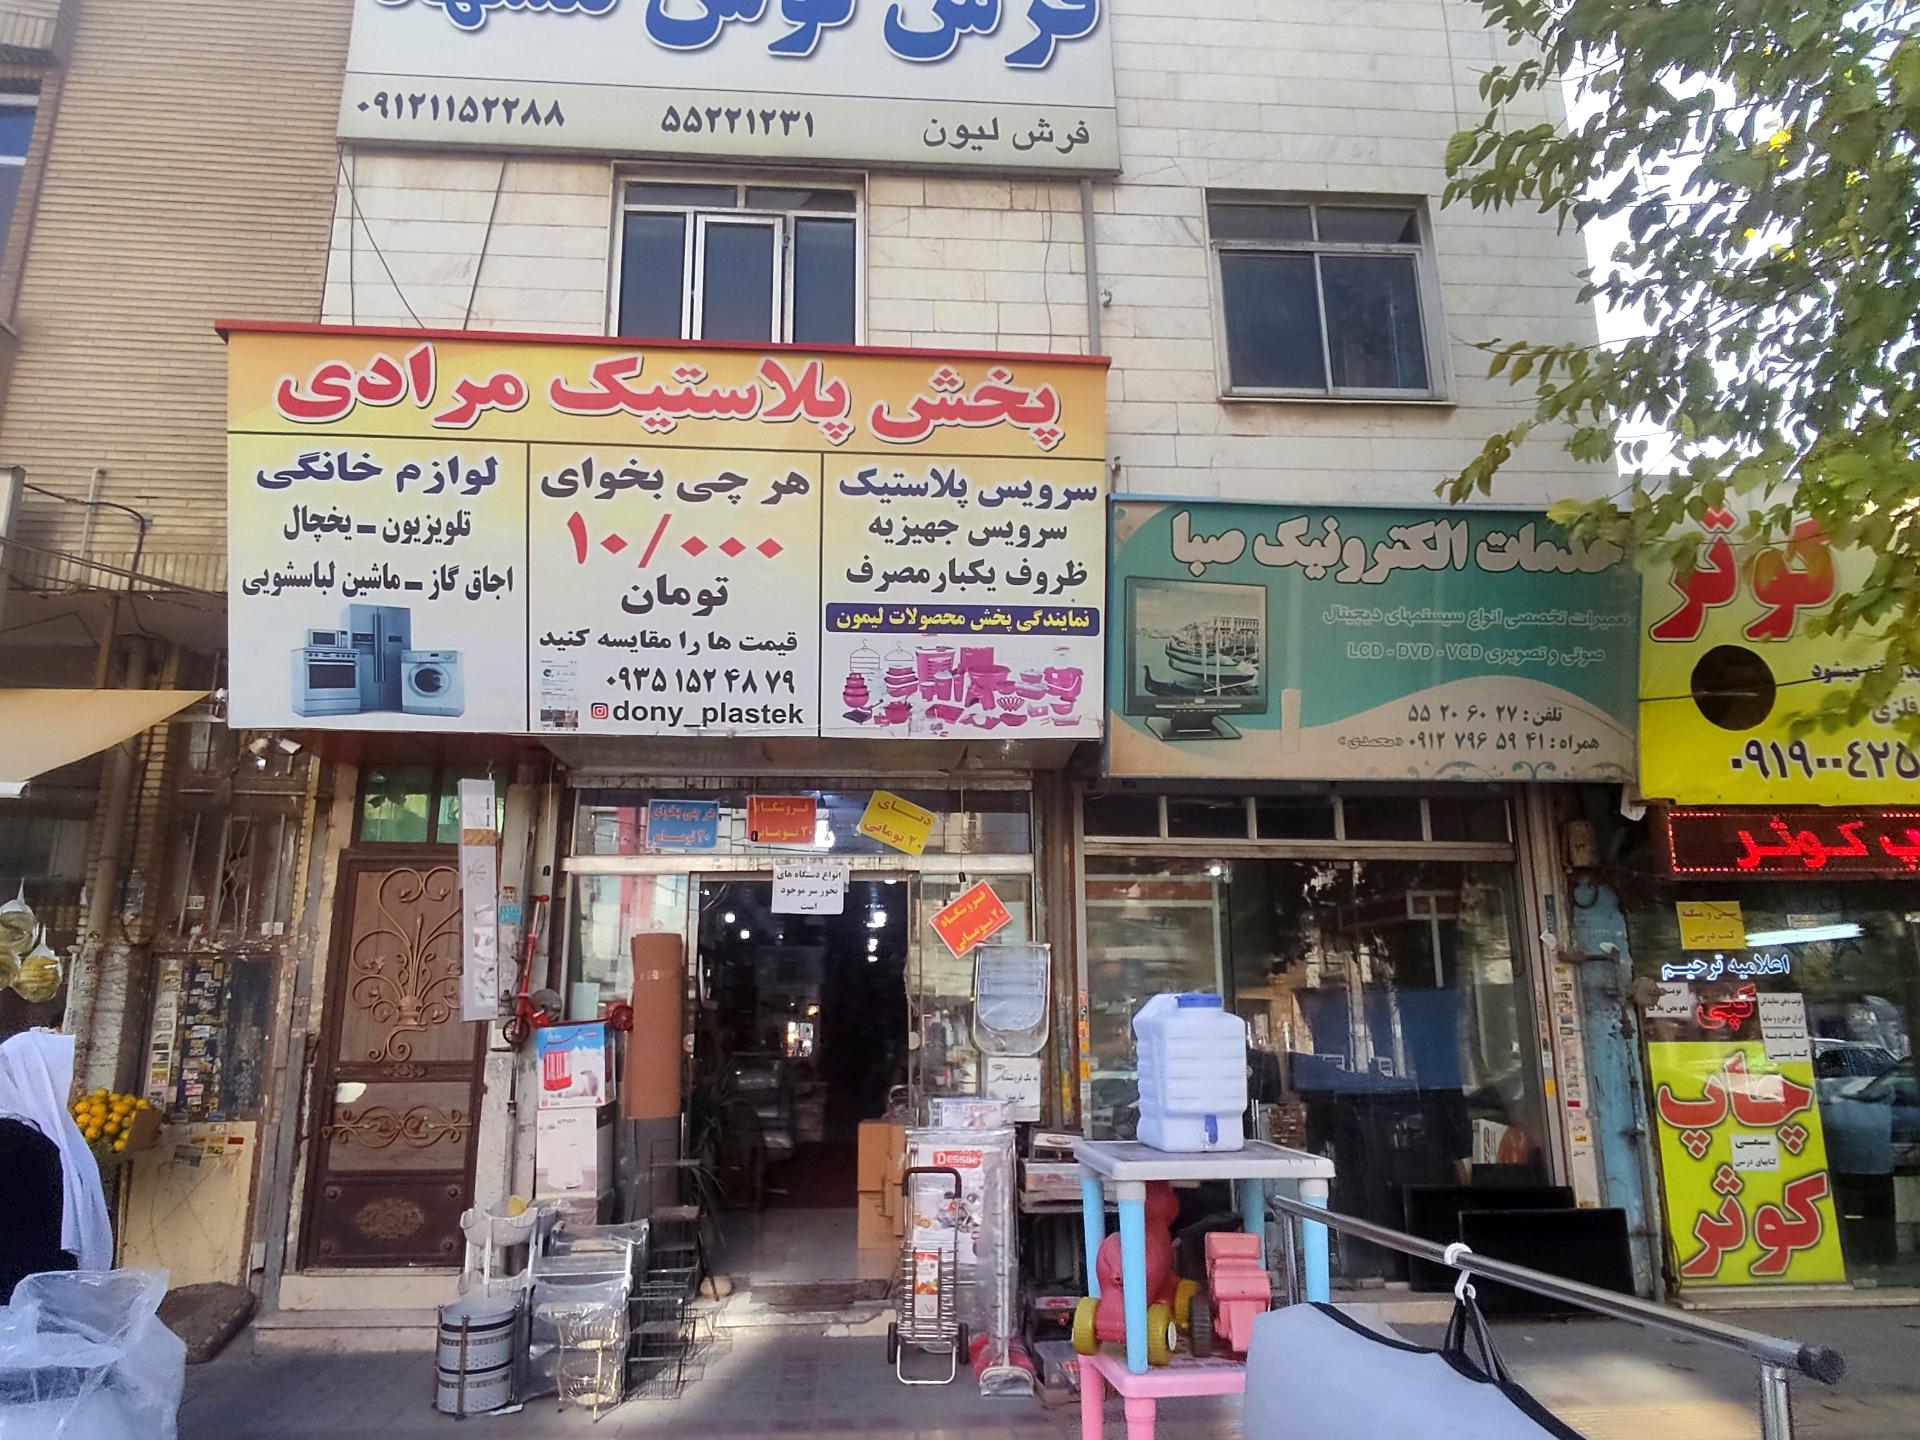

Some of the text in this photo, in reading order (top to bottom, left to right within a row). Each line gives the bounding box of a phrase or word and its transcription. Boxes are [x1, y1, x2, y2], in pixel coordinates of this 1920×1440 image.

[357, 91, 565, 127] ۰۹۱۲۱۱۵۲۲۸۸
[661, 105, 815, 139] ۵۵۲۲۱۲۳۱
[923, 117, 1090, 153] فرش لیون
[276, 344, 1062, 449] پخش پلاستیک مرادی
[257, 451, 498, 495] لوازم خانگی
[541, 456, 810, 505] هر چی بخوای
[840, 468, 1097, 509] سرویس پلاستیک
[284, 504, 351, 542] یخچال
[382, 509, 471, 546] تلویزیون
[567, 511, 784, 568] ۱۰/۰۰۰
[869, 516, 1067, 547] سرویس جهیزیه
[1171, 510, 1247, 577] صبا
[1253, 515, 1469, 584] الکترونیک
[242, 560, 335, 596] لباسشویی
[342, 562, 400, 597] ماشین
[428, 564, 460, 600] گاز
[465, 565, 513, 601] اجاق
[1006, 558, 1087, 594] ظروف
[621, 573, 729, 616] تومان
[837, 607, 1089, 632] نمایندگی پخش محصولات لیمون
[1322, 604, 1382, 625] دیجیتال
[1468, 607, 1503, 630] انواع
[1504, 608, 1568, 628] تخصصی
[540, 629, 798, 656] قیمت ها را مقایسه کنید
[1347, 642, 1382, 659] LCD
[1396, 643, 1433, 660] DVD
[1446, 644, 1482, 660] VCD
[1560, 647, 1605, 667] صوتی
[822, 871, 841, 881] انواع
[800, 902, 818, 910] است
[1661, 954, 1790, 981] اعلامیه ترحیم
[1658, 1051, 1813, 1159] چاپ
[1681, 1165, 1828, 1278] کوثر
